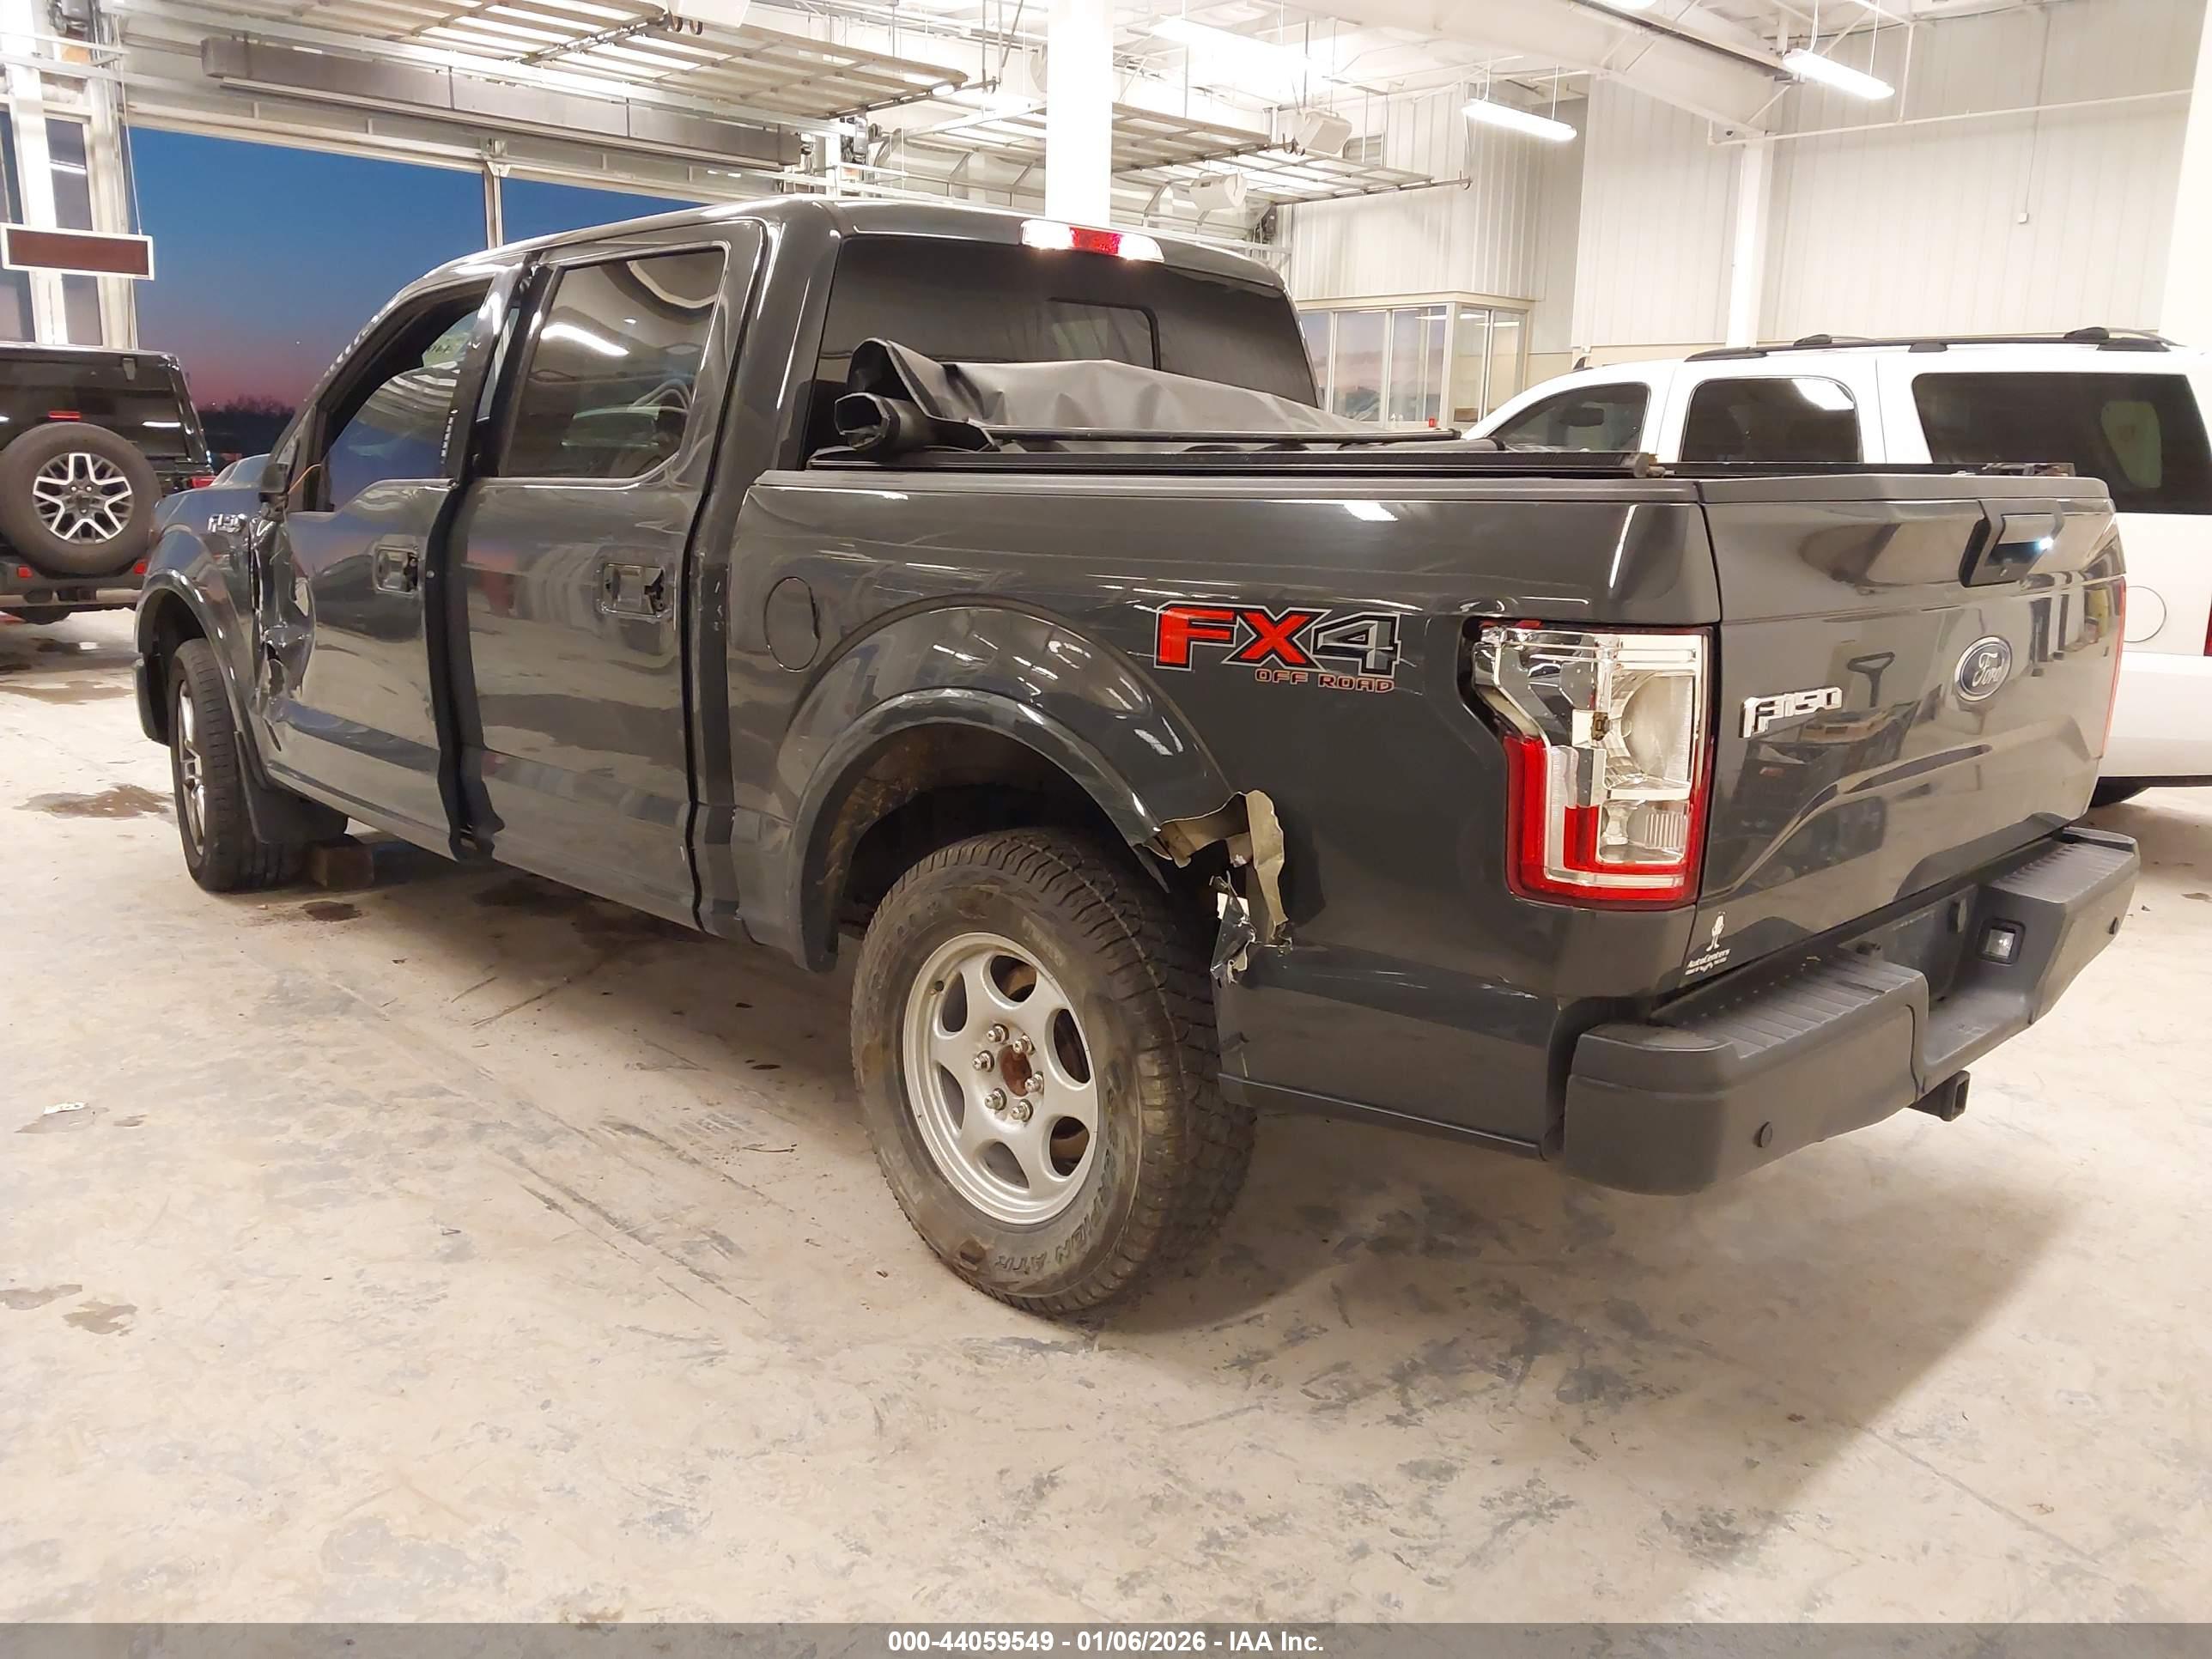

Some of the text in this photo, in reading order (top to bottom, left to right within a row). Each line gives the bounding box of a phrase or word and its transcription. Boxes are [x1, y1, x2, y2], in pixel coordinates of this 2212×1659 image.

[1154, 600, 1401, 678] FX4
[1255, 669, 1395, 693] OFF ROAD
